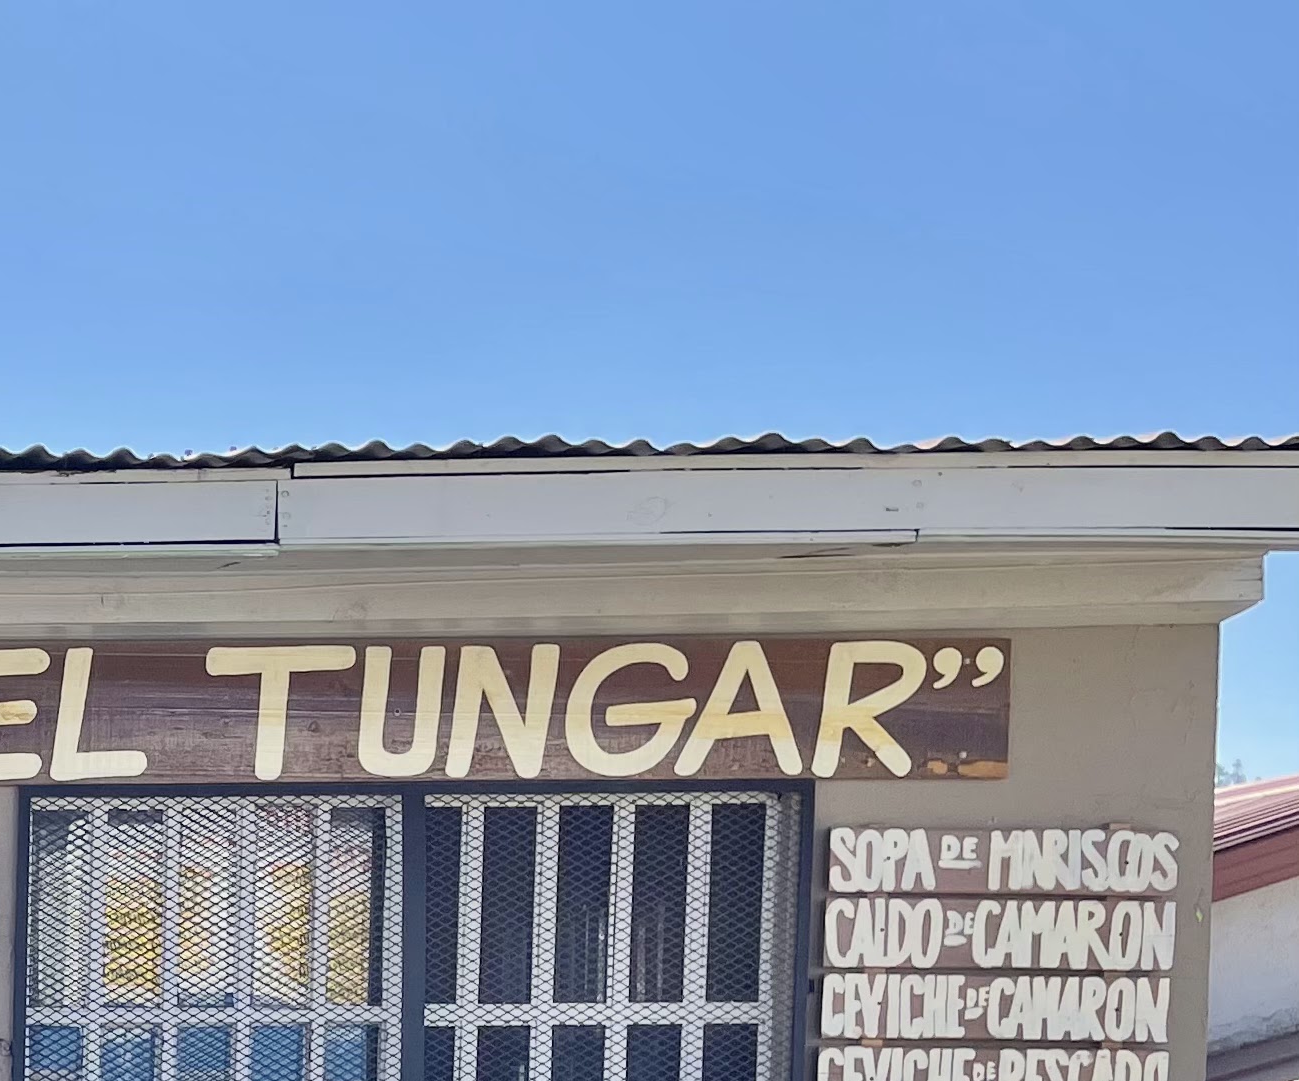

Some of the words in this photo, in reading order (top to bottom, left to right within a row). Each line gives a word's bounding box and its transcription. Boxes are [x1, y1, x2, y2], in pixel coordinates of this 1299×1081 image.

[206, 641, 1004, 780] TUNGAR”
[830, 827, 935, 892] SOPA
[941, 834, 979, 862] DE
[988, 828, 1180, 892] MARISCOS
[825, 898, 943, 968] CALDO
[946, 910, 974, 938] DE
[972, 900, 1177, 970] CAMARON
[821, 973, 966, 1039] CEVICHE
[967, 987, 990, 1011] DE
[987, 975, 1171, 1043] CAMARON
